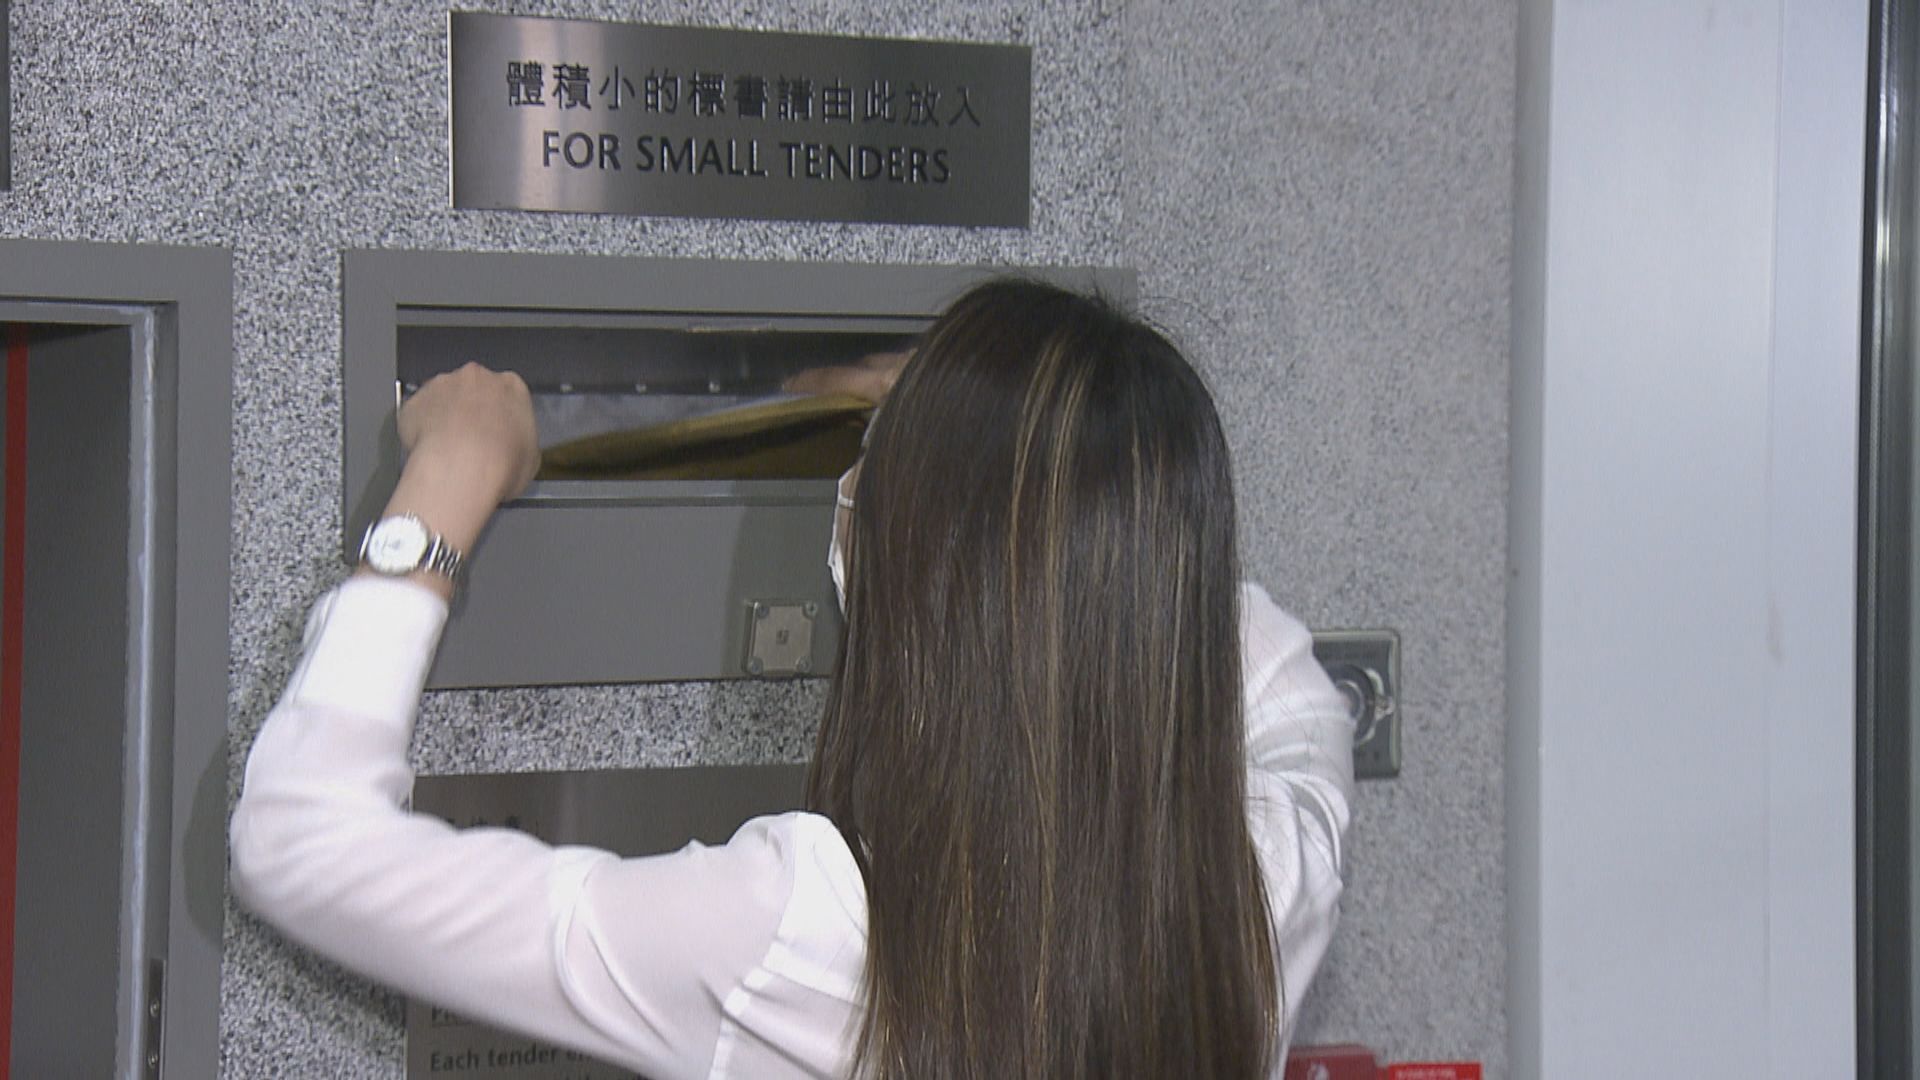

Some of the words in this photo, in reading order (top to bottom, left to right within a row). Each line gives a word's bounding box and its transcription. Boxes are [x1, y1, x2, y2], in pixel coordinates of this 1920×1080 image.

[506, 61, 982, 128] 體積小的標書請由此放入
[542, 131, 621, 170] FOR
[636, 136, 768, 178] SMALL
[779, 142, 951, 184] TENDERS
[430, 1050, 479, 1072] Each
[488, 1043, 557, 1068] tender
